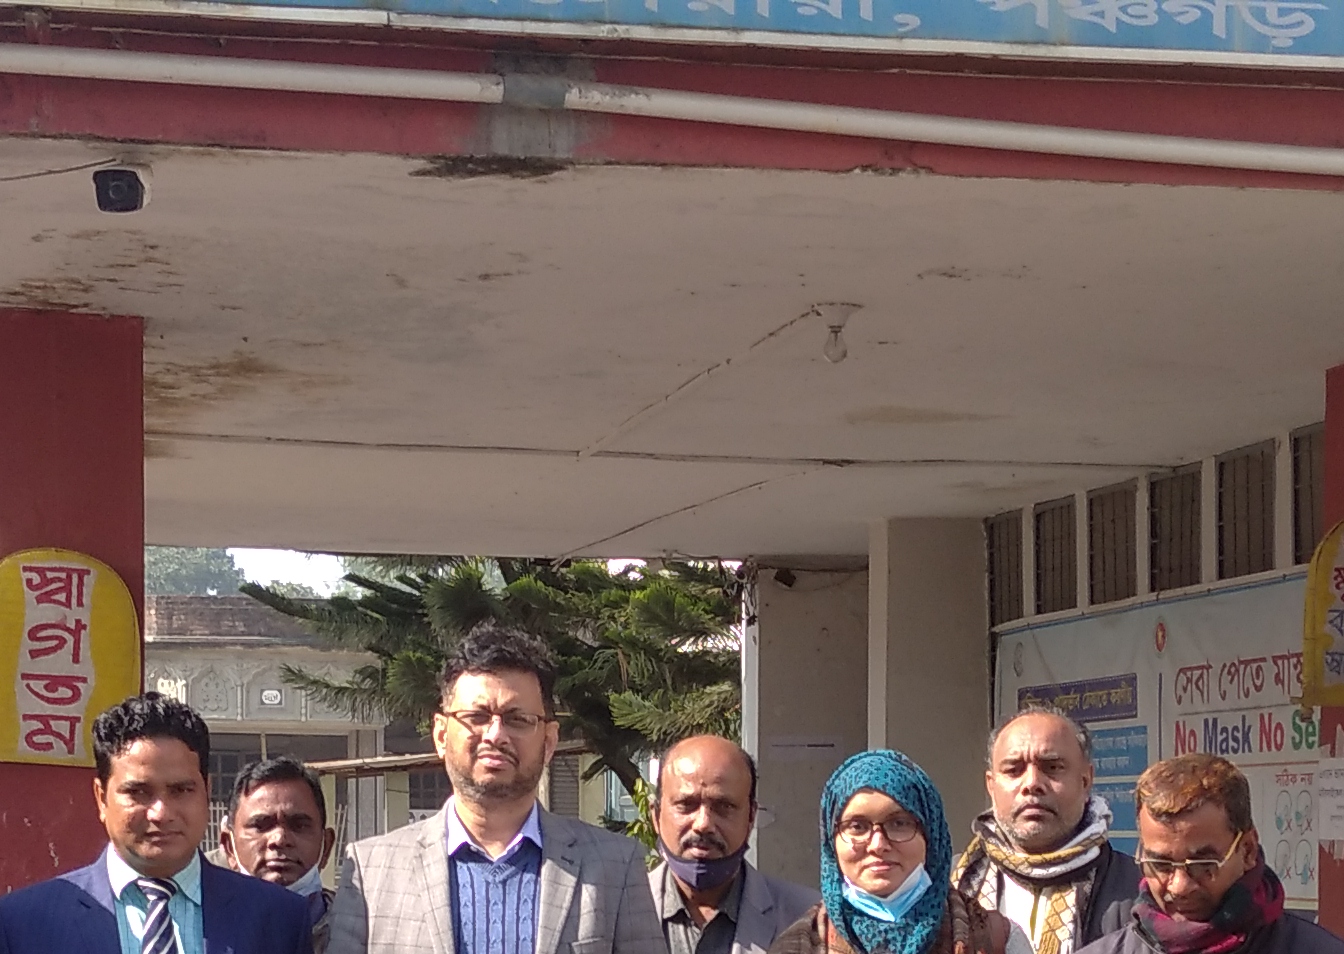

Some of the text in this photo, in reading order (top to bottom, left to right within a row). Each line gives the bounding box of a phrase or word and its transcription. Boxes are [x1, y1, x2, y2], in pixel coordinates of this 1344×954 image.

[20, 565, 92, 756] স্বাগতম
[1174, 658, 1213, 705] সেবা
[1218, 655, 1268, 701] পেতে
[1175, 720, 1198, 756] No
[1203, 714, 1253, 755] Mask
[1259, 712, 1285, 752] No
[1291, 709, 1321, 751] Se
